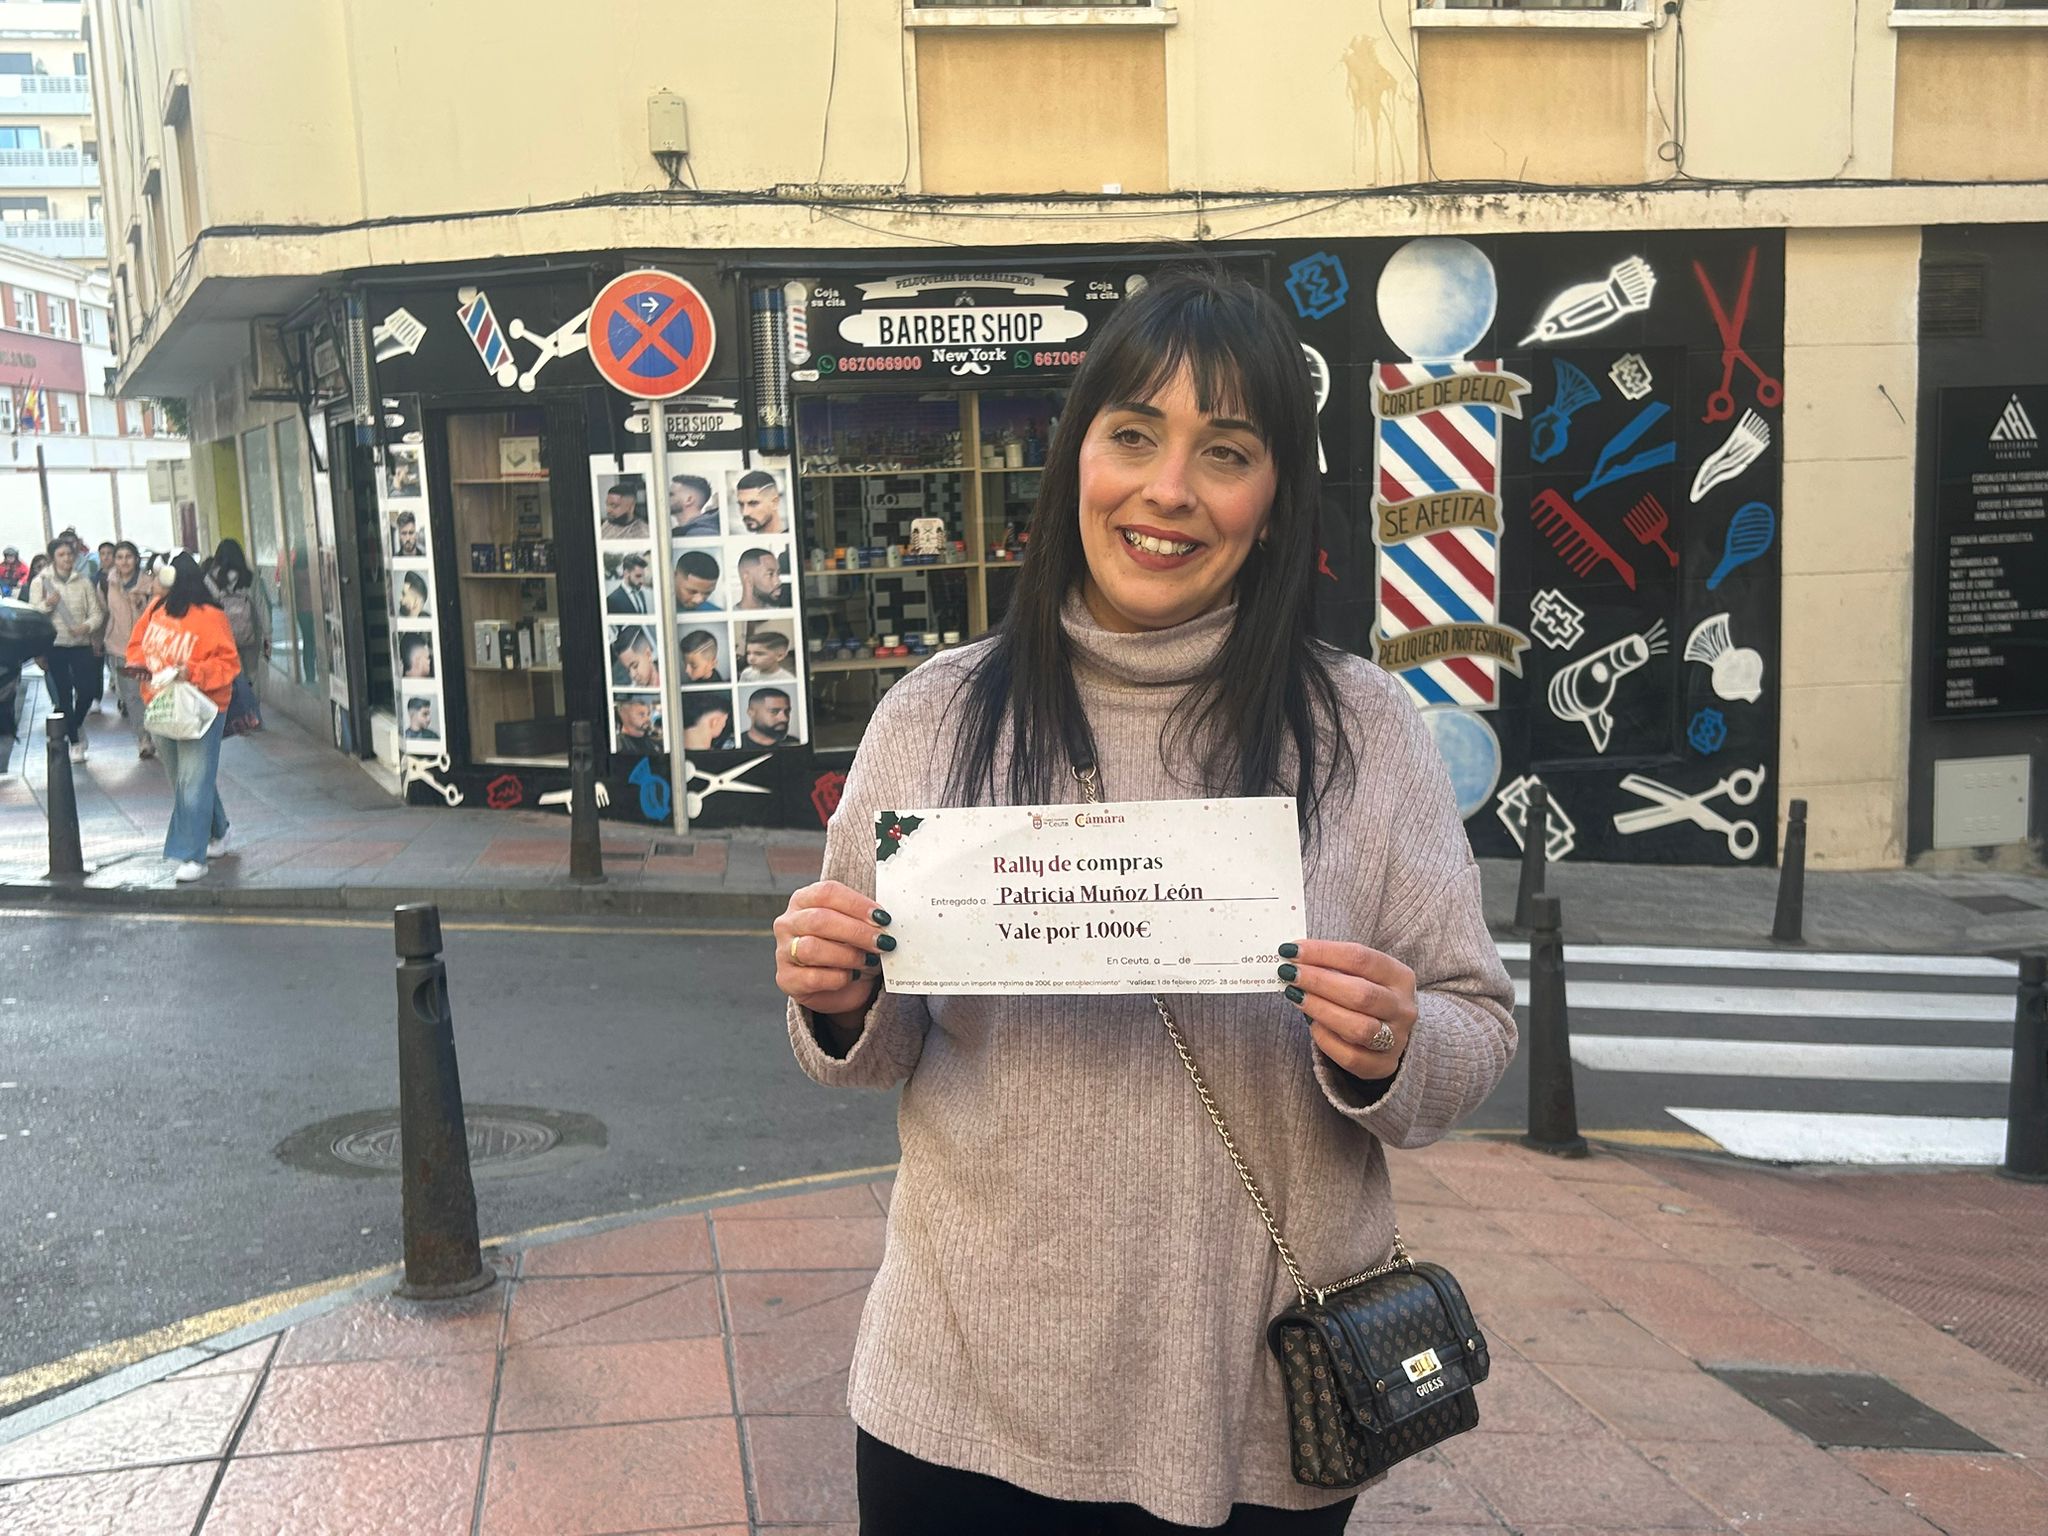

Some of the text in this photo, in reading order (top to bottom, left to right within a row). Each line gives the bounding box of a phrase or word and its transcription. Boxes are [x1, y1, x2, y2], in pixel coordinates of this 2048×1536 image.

[814, 288, 839, 299] Coja
[1089, 281, 1112, 292] Coja
[811, 298, 846, 307] su cita
[1086, 291, 1119, 300] su cita
[932, 348, 1007, 362] New York
[1034, 351, 1087, 366] 66706
[1381, 376, 1506, 415] CORTE DE PELO
[641, 416, 691, 433] BBER
[1385, 497, 1486, 537] SE AFEITA
[1379, 627, 1516, 665] PELUQUERO PROFESIONAL
[1075, 813, 1125, 828] Cámara
[993, 855, 1163, 877] Rally de compras
[931, 897, 978, 908] Entregado
[1000, 886, 1075, 904] Patricia
[1080, 883, 1148, 902] Muñoz
[1154, 882, 1204, 901] León
[998, 920, 1152, 944] Vale por 1.000€
[1106, 957, 1119, 966] En
[1178, 956, 1191, 965] de
[1241, 955, 1254, 964] de
[1256, 955, 1280, 964] 2025
[1416, 1376, 1444, 1397] GUESS
